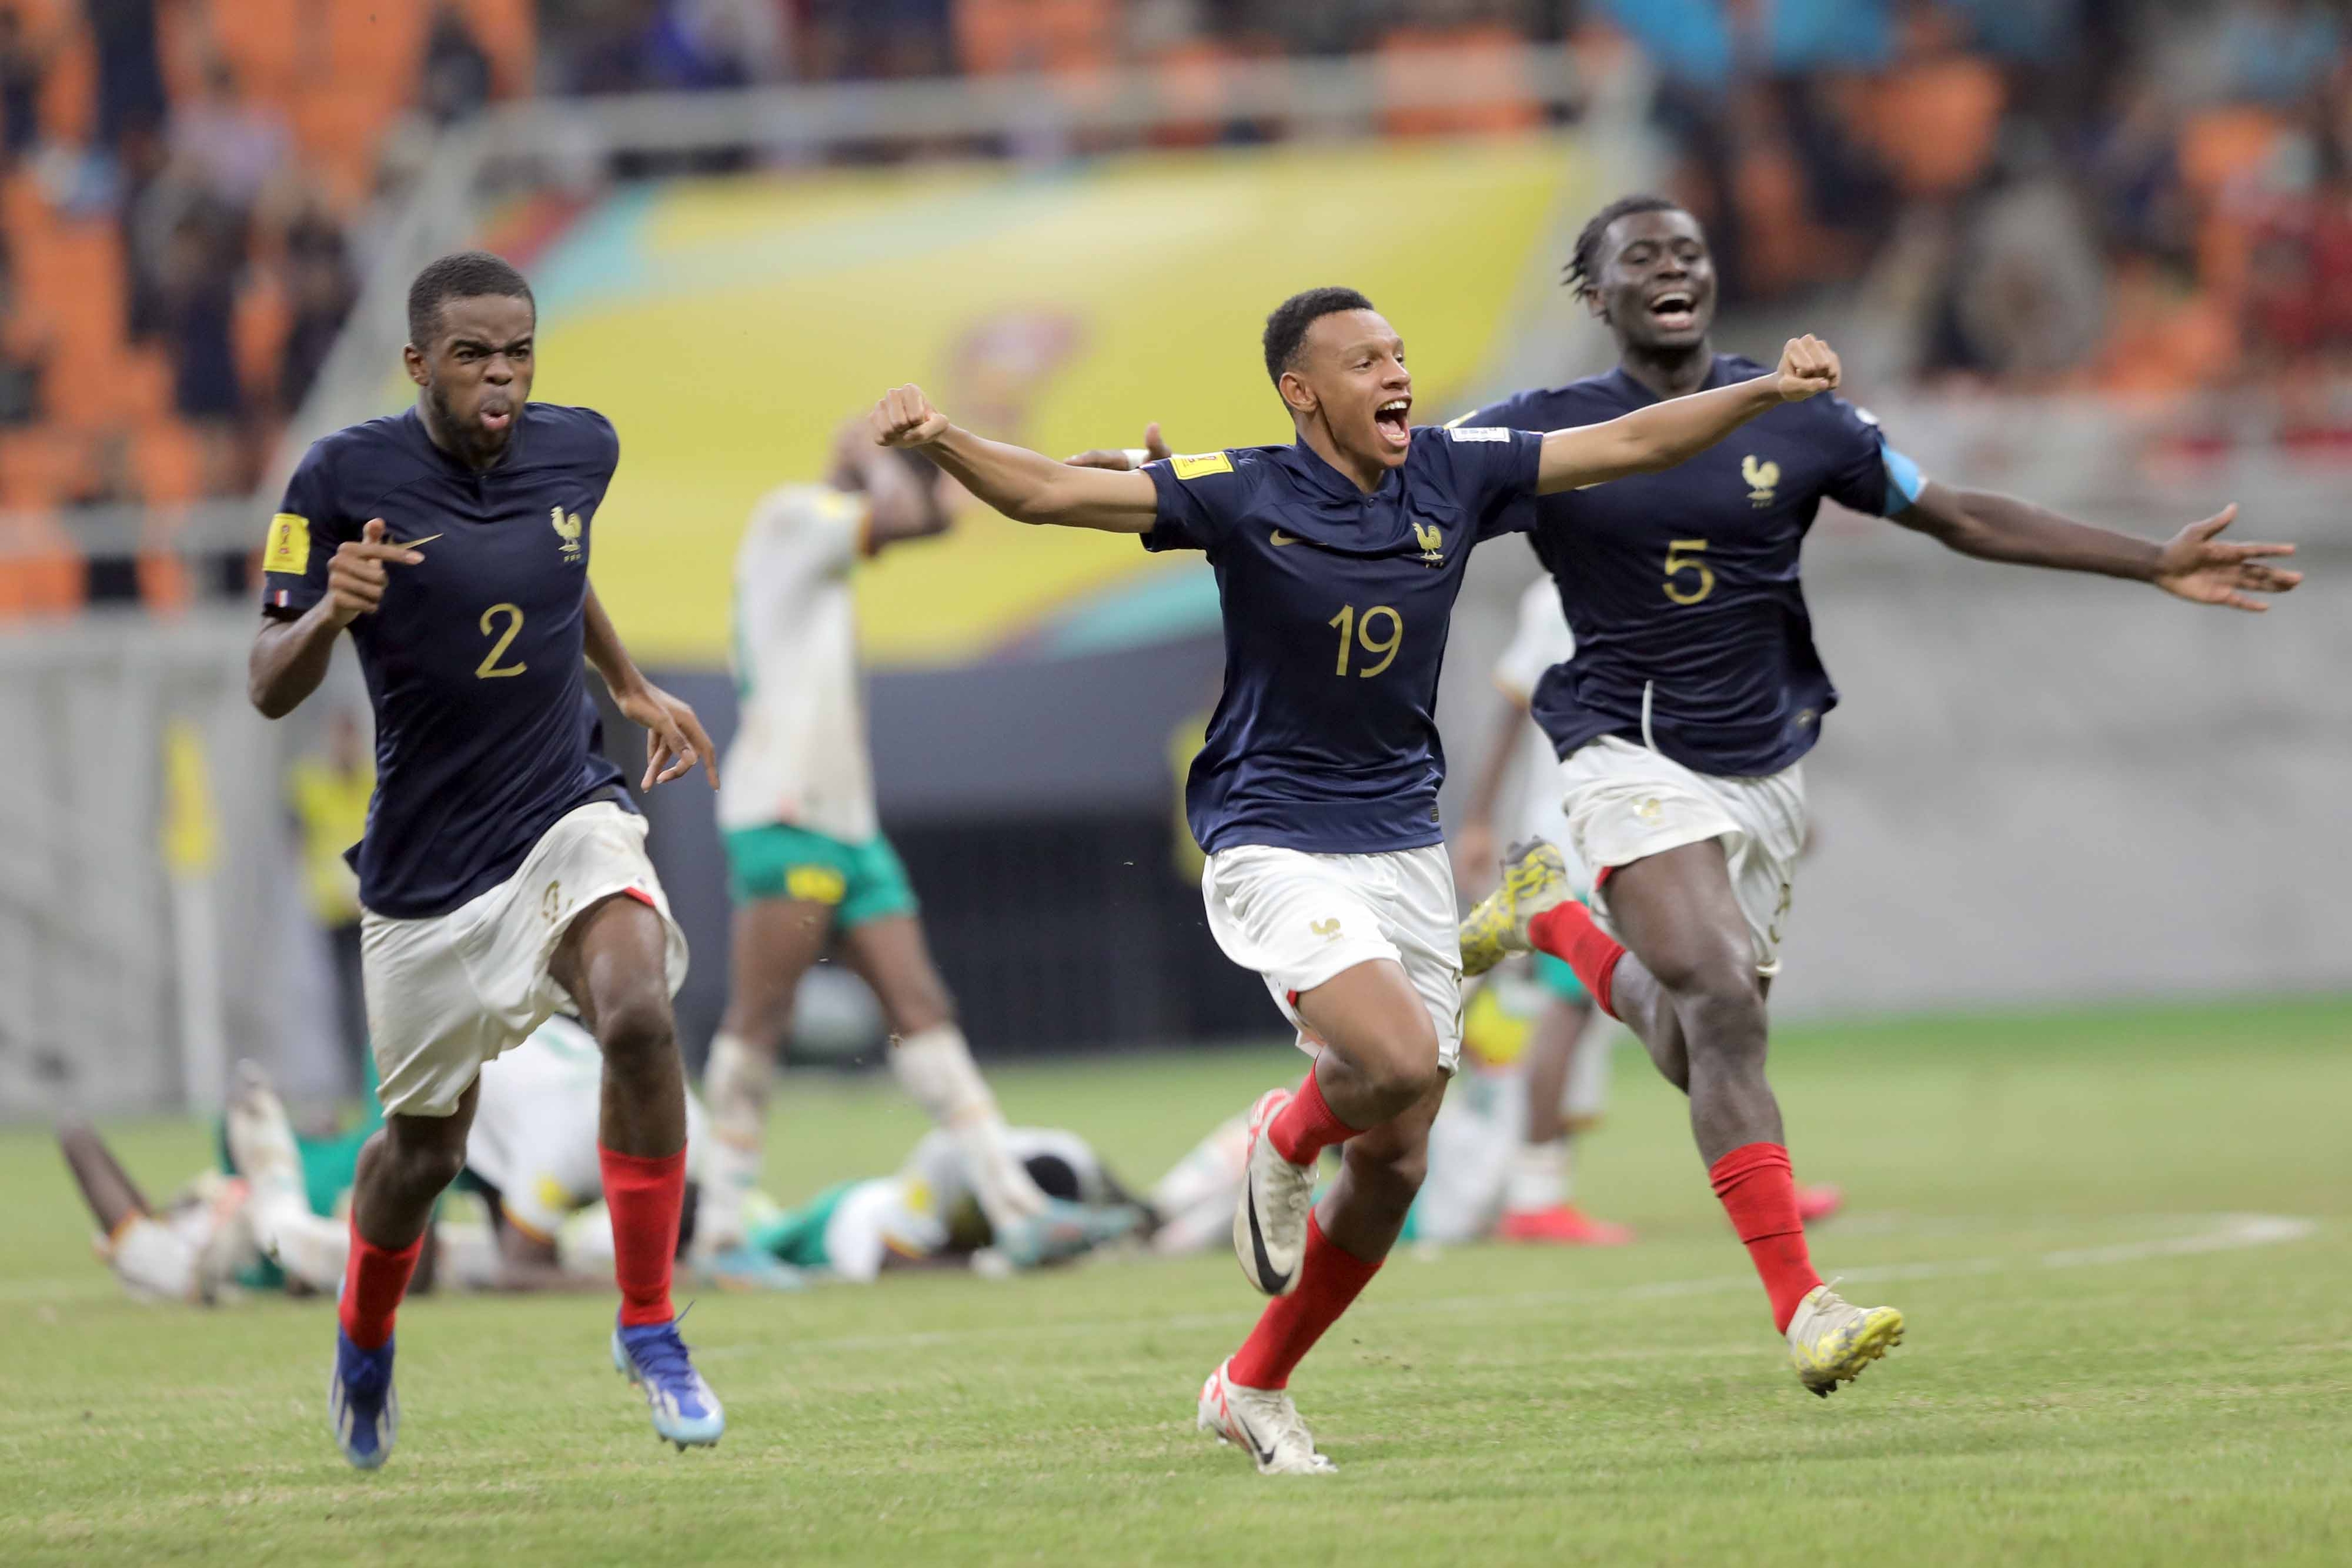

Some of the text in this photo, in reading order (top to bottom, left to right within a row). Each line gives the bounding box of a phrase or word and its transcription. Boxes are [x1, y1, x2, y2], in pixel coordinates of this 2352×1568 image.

[1663, 540, 1714, 605] 5
[475, 603, 527, 679] 2
[1329, 605, 1403, 678] 19
